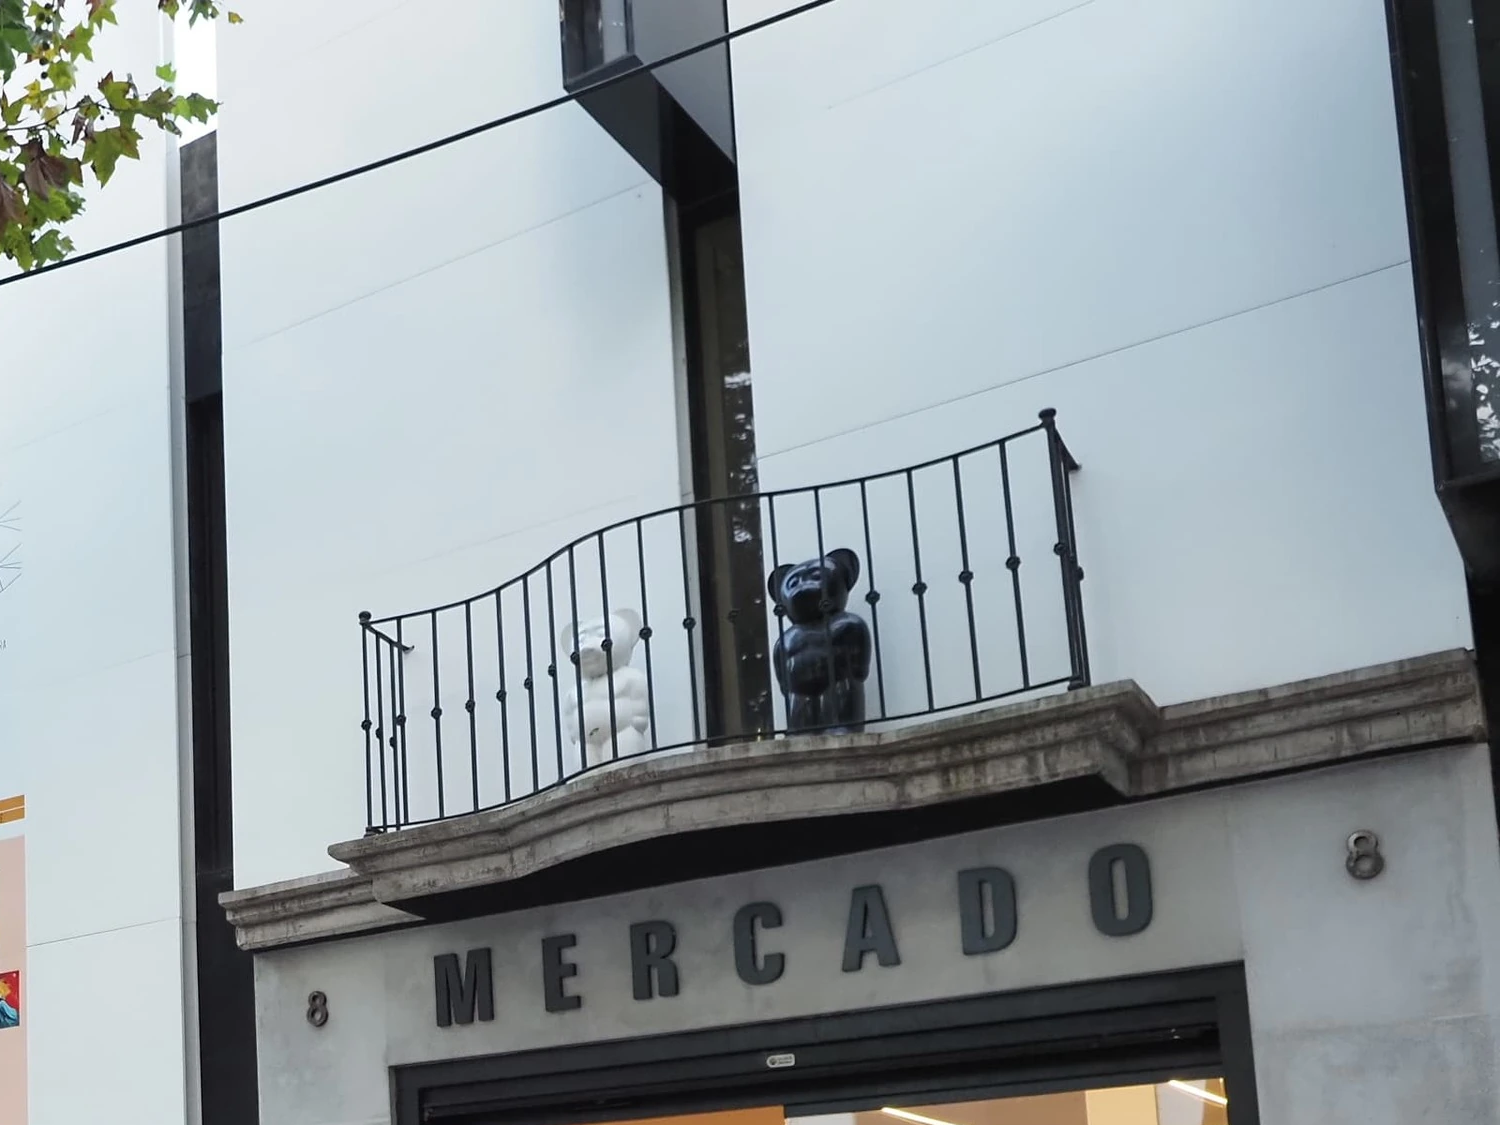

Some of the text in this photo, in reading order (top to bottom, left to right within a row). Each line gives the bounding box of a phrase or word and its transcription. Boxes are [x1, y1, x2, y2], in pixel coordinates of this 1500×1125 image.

[1345, 829, 1384, 880] 8
[432, 843, 1154, 1027] MERCADO
[306, 990, 329, 1027] 8
